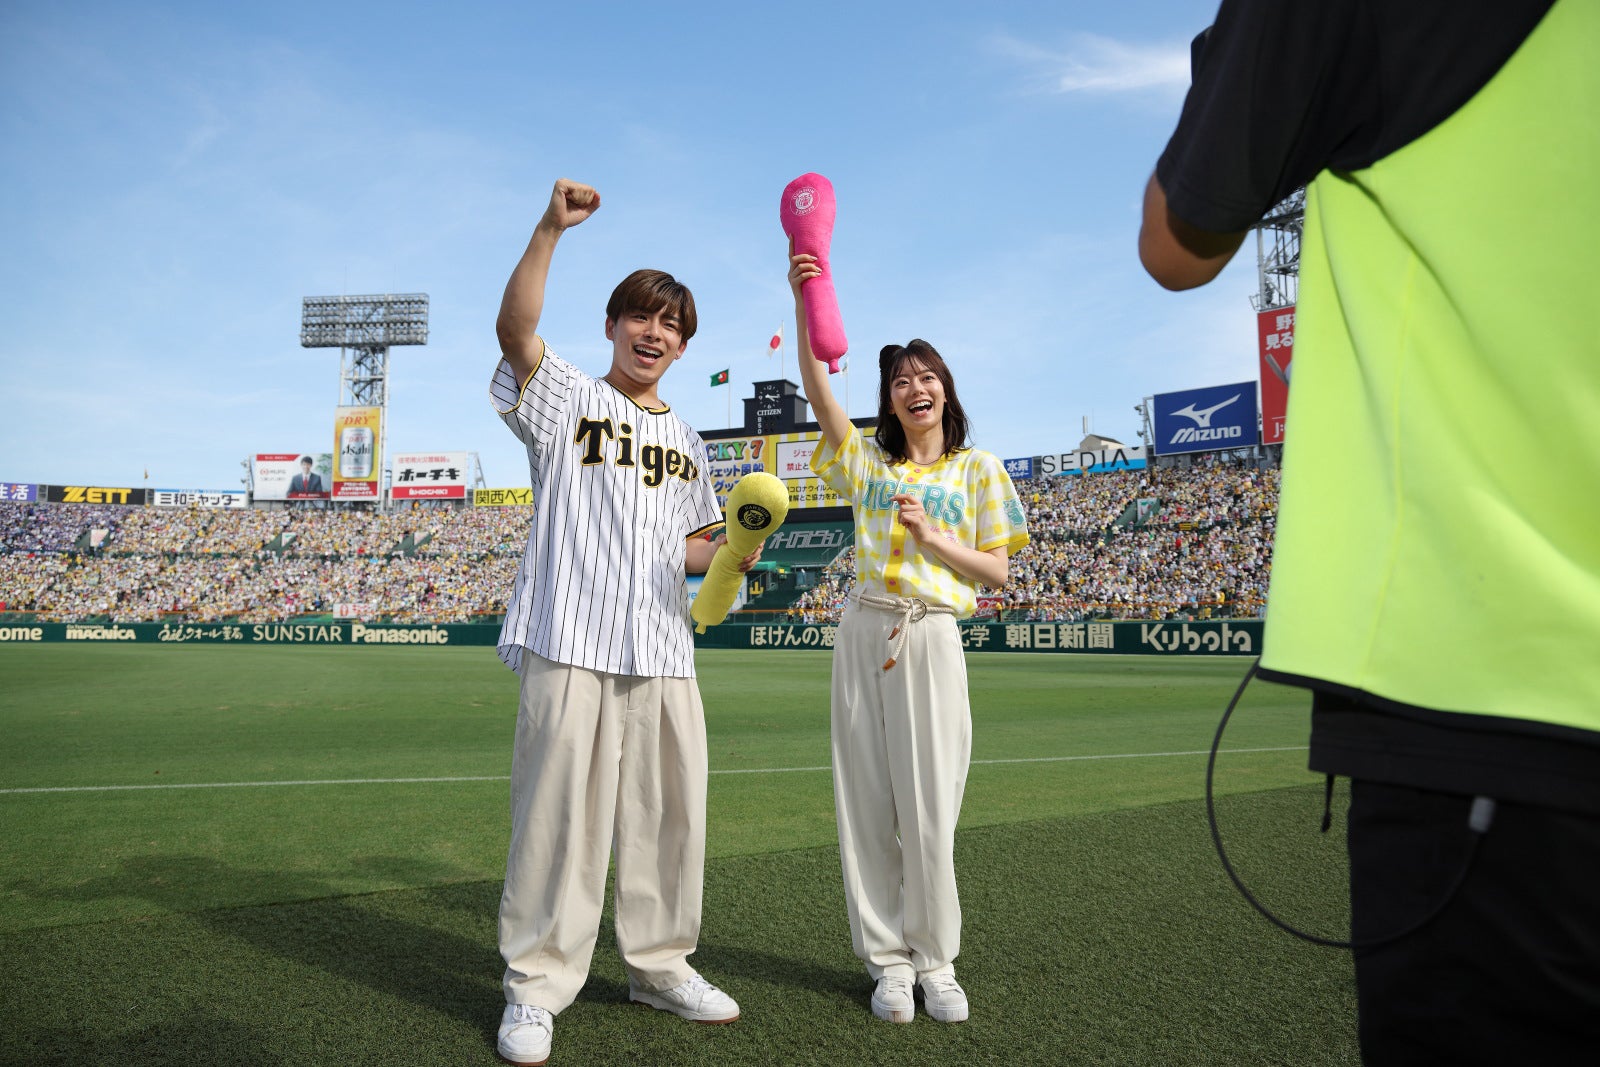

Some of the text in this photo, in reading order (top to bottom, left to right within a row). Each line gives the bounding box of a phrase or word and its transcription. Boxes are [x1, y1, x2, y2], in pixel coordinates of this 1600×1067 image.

[1276, 313, 1296, 331] 野
[756, 408, 782, 417] CITIZEN
[750, 440, 764, 459] 7
[398, 467, 460, 481] ホーチキ
[62, 486, 132, 504] ZETT
[252, 625, 342, 642] SUNSTAR
[351, 625, 448, 644] Panasonic
[1005, 624, 1114, 648] 朝日新聞
[1141, 623, 1252, 651] Kubota
